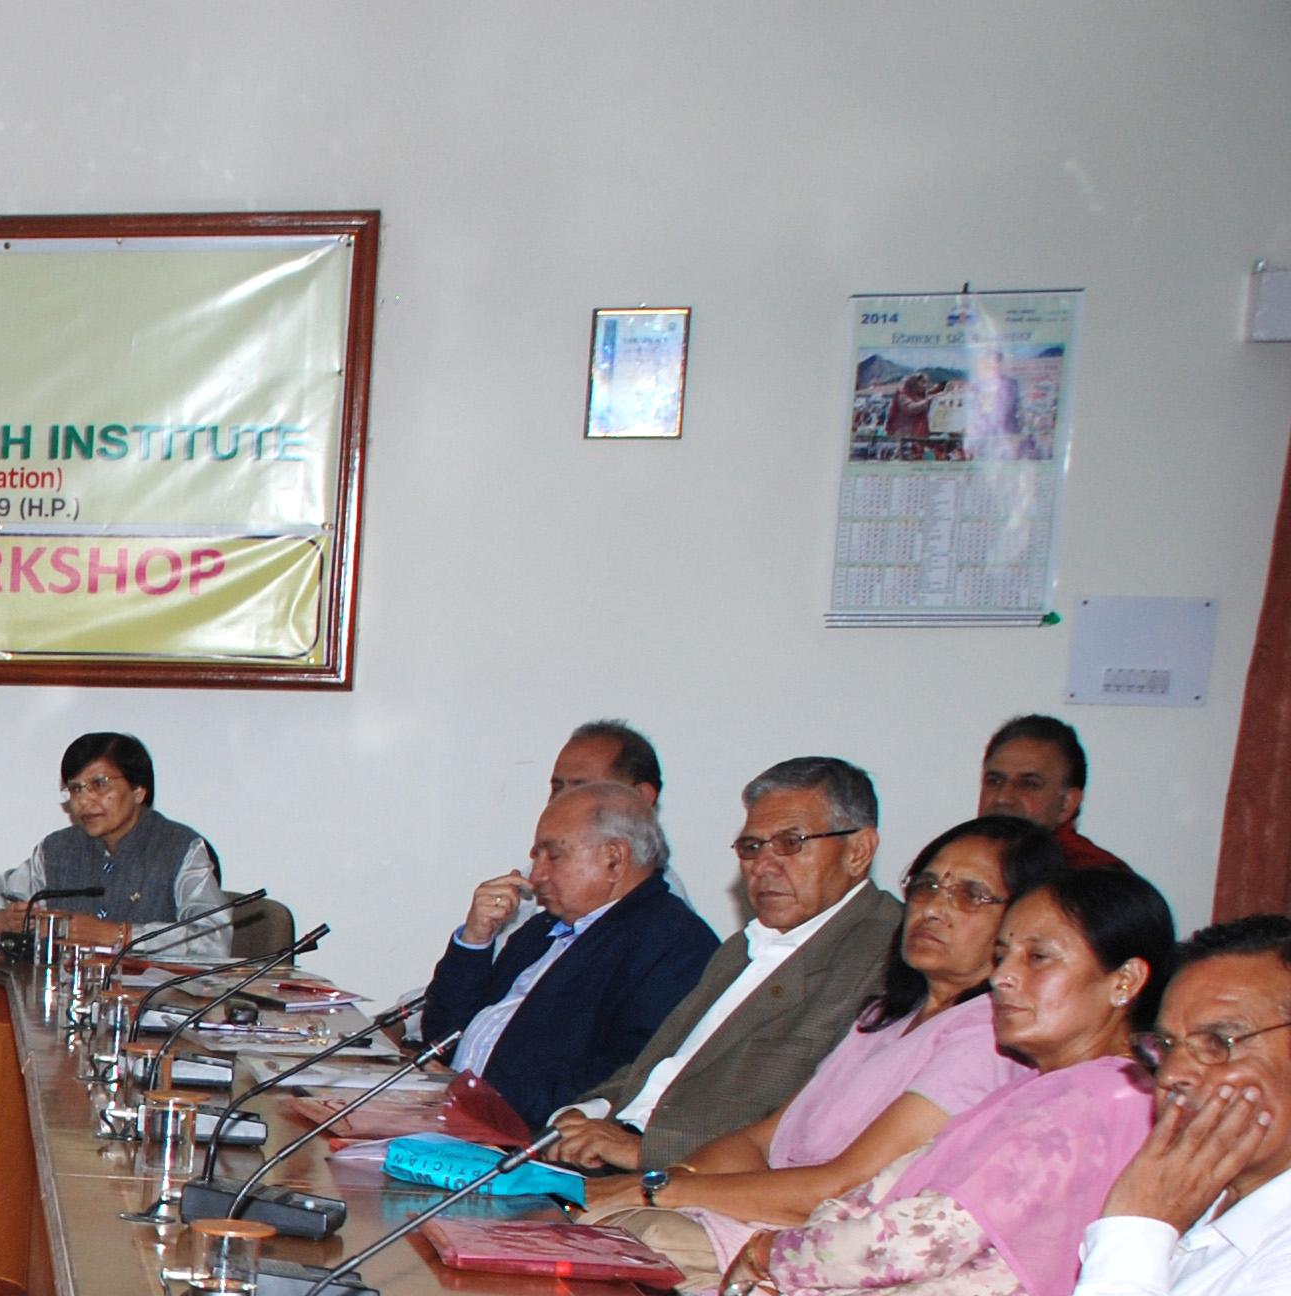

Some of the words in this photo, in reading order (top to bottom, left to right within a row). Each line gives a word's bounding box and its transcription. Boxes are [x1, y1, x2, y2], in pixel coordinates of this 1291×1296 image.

[861, 313, 899, 325] 2014
[49, 424, 310, 463] INSTITUTE
[19, 497, 80, 521] (H.P.)
[393, 1153, 485, 1177] PTICIAN
